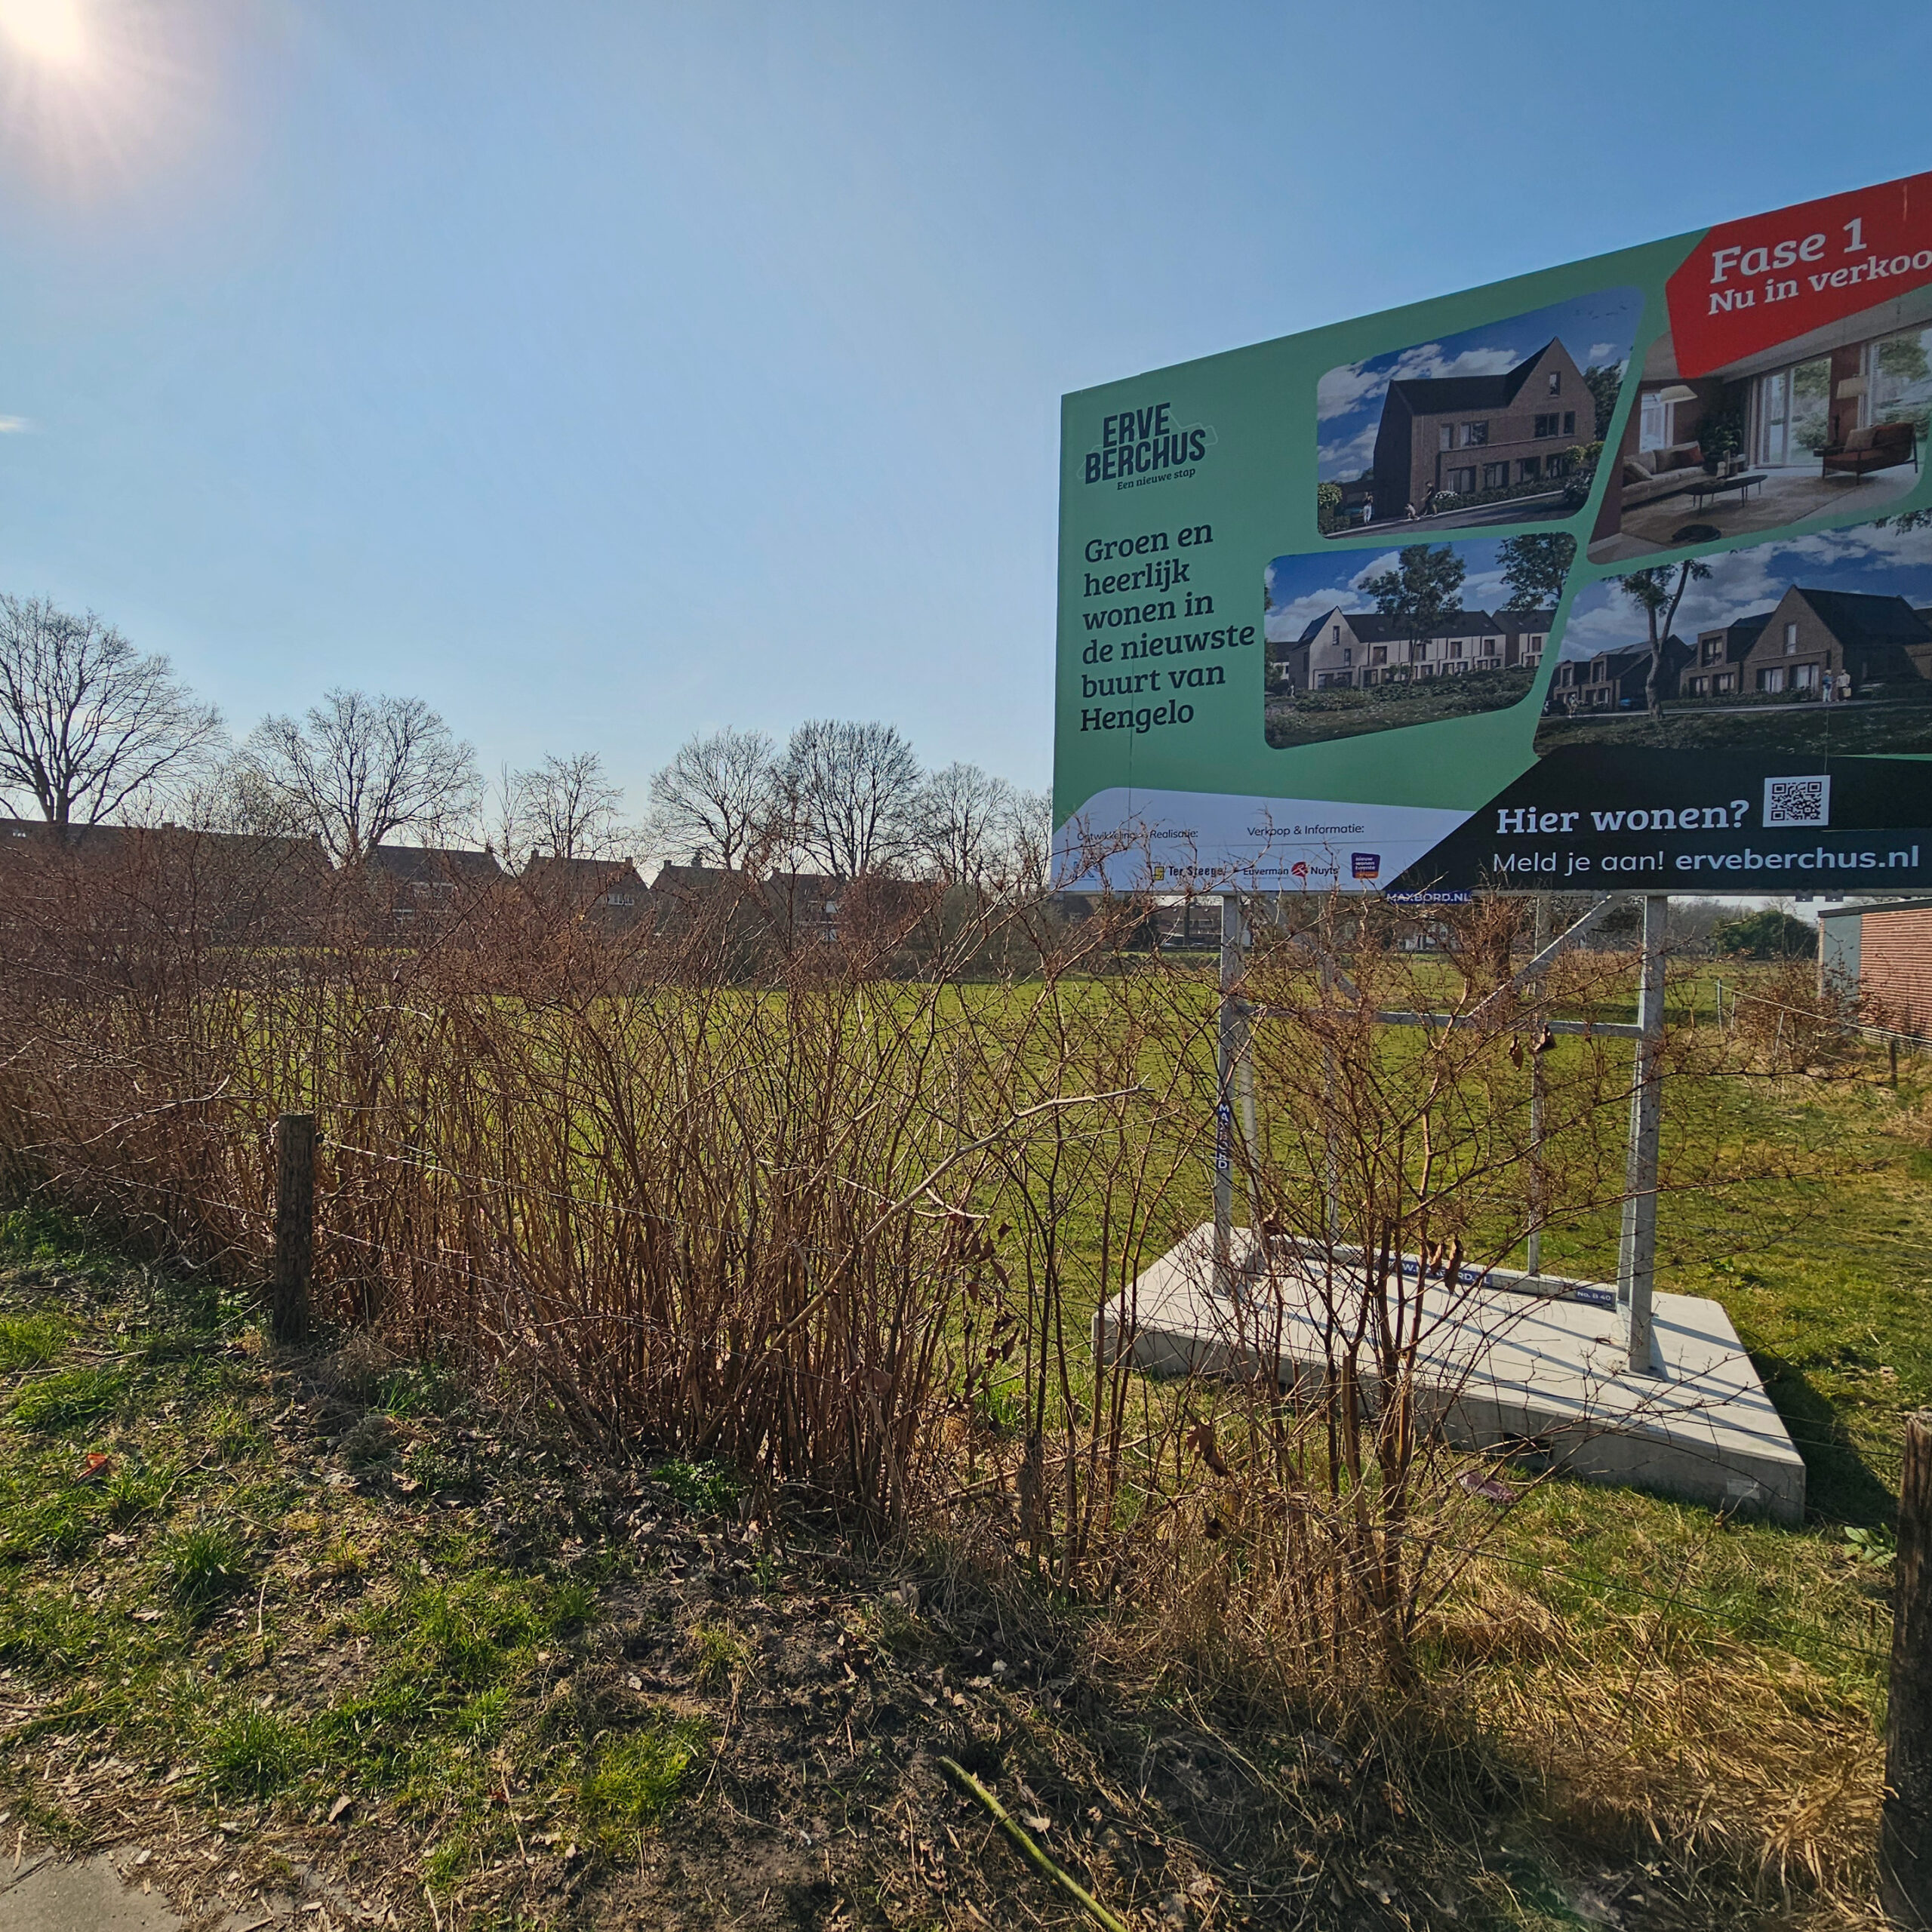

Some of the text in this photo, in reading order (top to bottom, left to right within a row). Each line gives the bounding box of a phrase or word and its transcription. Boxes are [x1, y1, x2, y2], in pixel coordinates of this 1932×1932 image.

[1710, 217, 1867, 285] Fase 1
[1708, 288, 1755, 315] Nu
[1764, 278, 1799, 303] in
[1103, 402, 1171, 448] ERVE
[1085, 429, 1206, 484] BERCHUS
[1117, 468, 1195, 491] Een nieuwe stap
[1084, 524, 1214, 563] Groen en
[1083, 558, 1190, 598] heerlijk
[1082, 591, 1214, 631] wonen in
[1082, 625, 1255, 664] de nieuwste
[1081, 665, 1226, 698] buurt van
[1080, 699, 1194, 734] Hengelo
[1247, 823, 1364, 837] Verkoop & Informatie:
[1497, 799, 1749, 833] Hier wonen?
[1169, 866, 1184, 875] Ter
[1311, 866, 1339, 876] Nuyts
[1493, 845, 1919, 876] Meld je aan! erveberchus.nl
[1387, 893, 1472, 903] MAXBORD.NL
